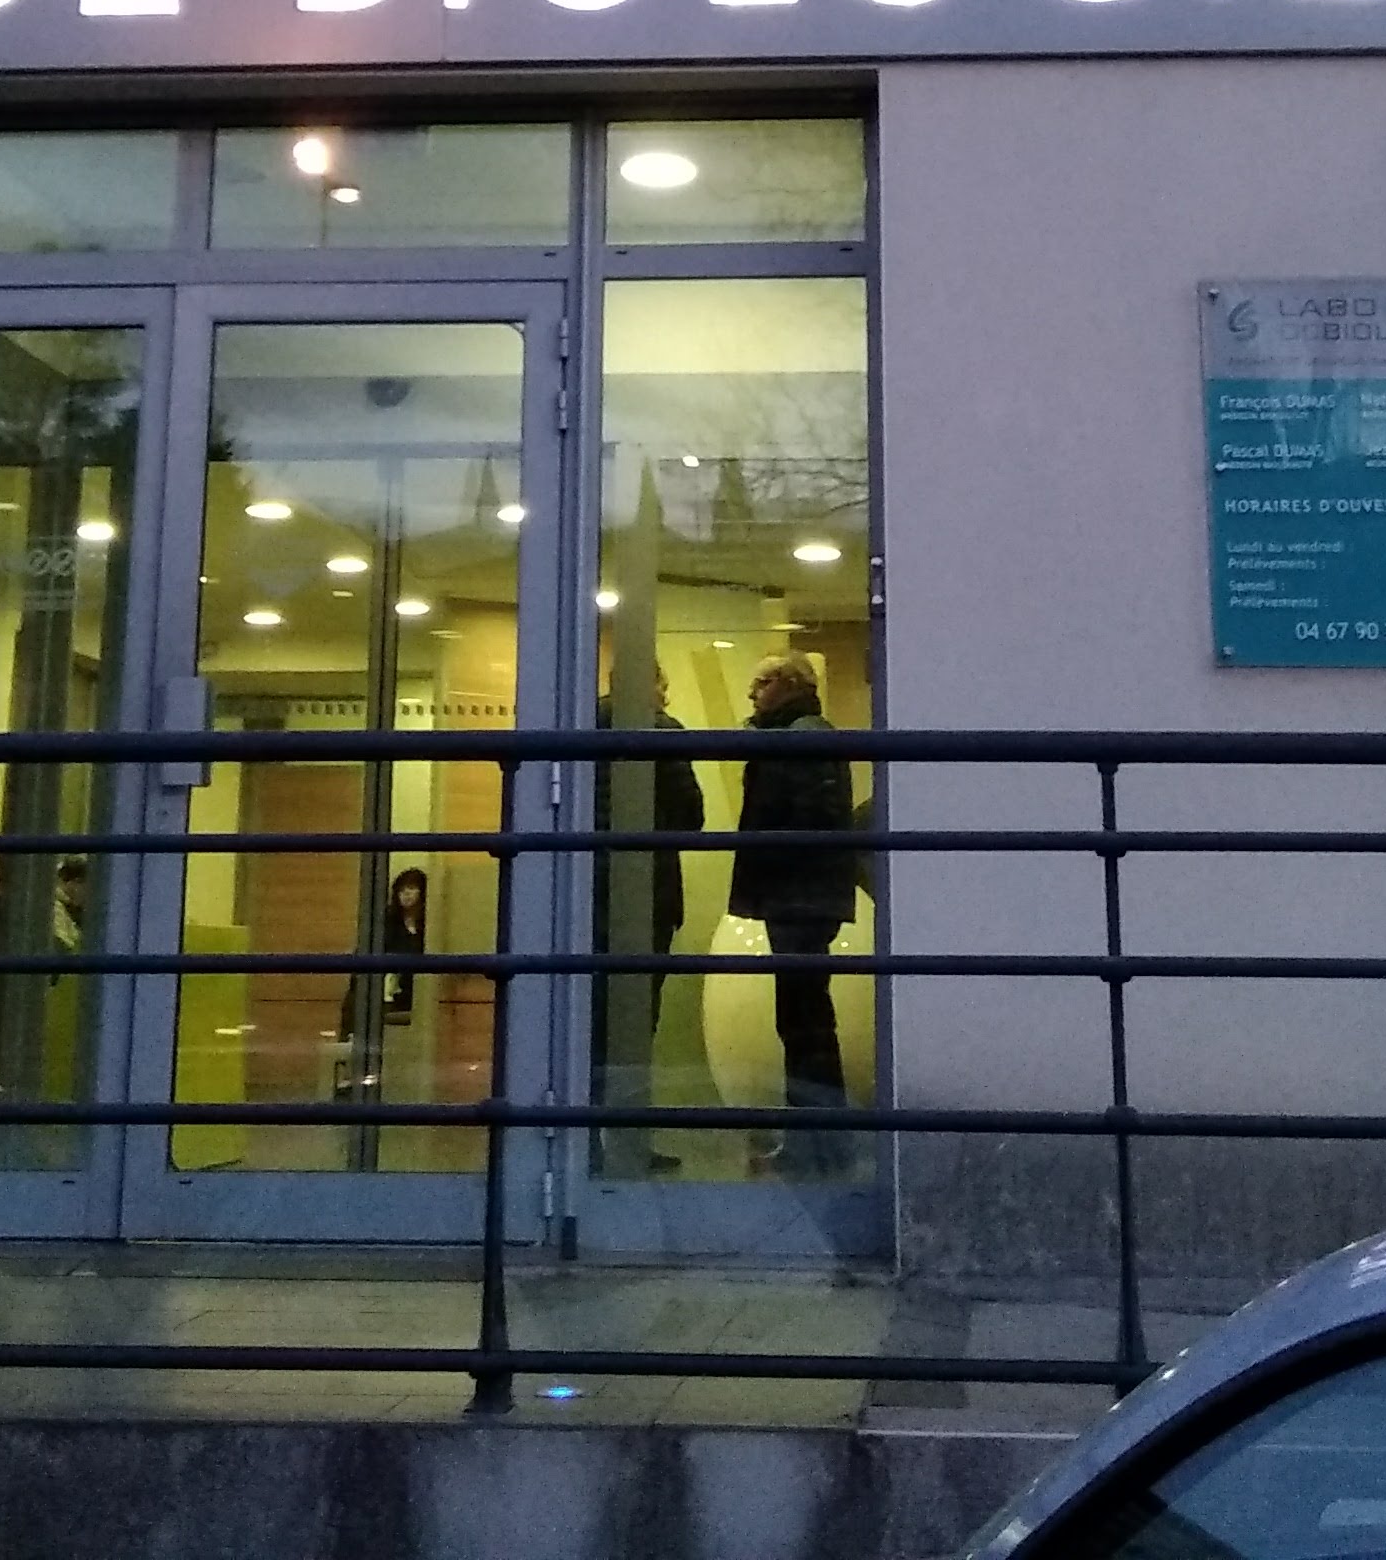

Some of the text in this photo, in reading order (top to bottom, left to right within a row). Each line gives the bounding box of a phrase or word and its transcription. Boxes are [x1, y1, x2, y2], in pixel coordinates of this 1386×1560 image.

[1224, 499, 1312, 513] HORAIRES
[1295, 622, 1319, 640] 04
[1326, 622, 1349, 640] 67
[1355, 622, 1379, 640] 90
